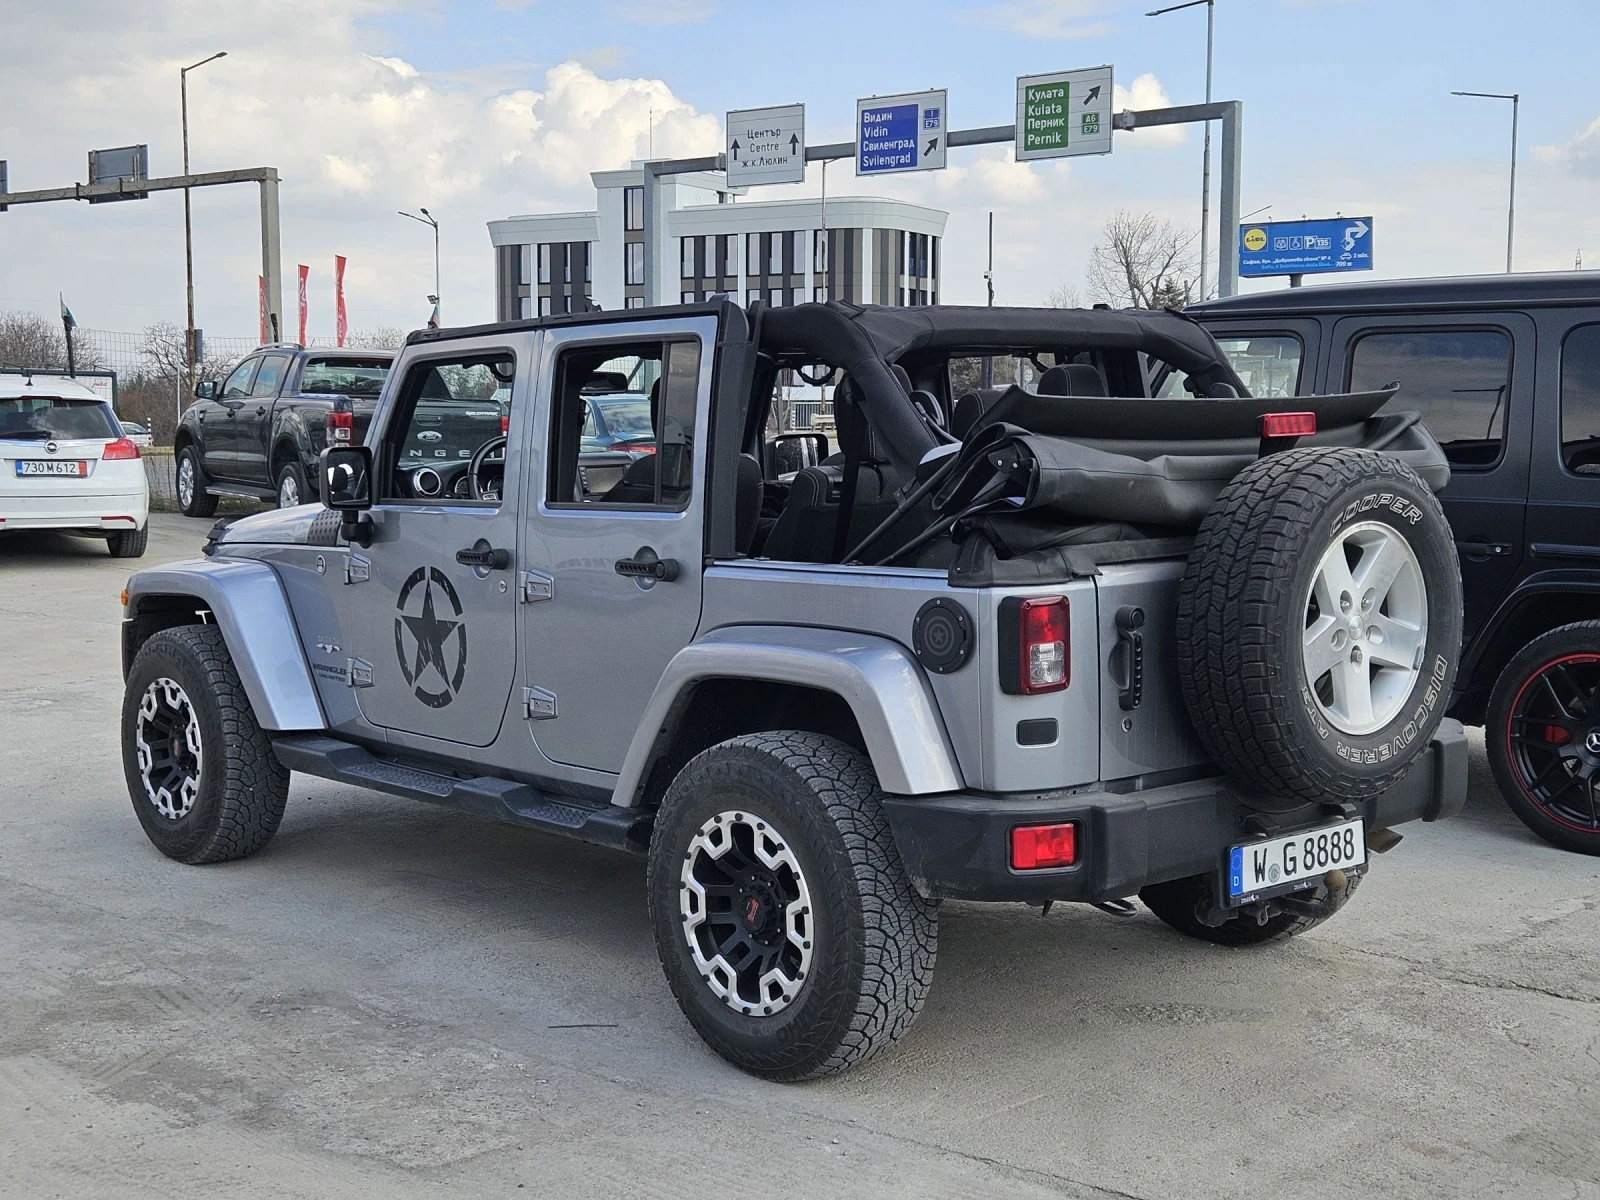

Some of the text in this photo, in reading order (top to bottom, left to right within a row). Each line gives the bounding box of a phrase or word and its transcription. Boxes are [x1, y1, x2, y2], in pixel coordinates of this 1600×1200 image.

[1028, 89, 1064, 102] Кулата
[1028, 103, 1062, 116] Kulata
[863, 112, 893, 123] Видин
[1027, 117, 1065, 130] Перник
[1085, 115, 1096, 123] A6
[925, 120, 938, 128] E79
[1083, 124, 1098, 133] E79
[747, 128, 781, 140] Център
[863, 127, 888, 138] Vidin
[1027, 131, 1062, 146] Pernik
[749, 142, 779, 153] Centre
[863, 139, 915, 152] Свиленград
[863, 152, 911, 167] Svilengrad
[1317, 239, 1329, 247] 135
[1328, 493, 1424, 538] COOPER
[1335, 654, 1448, 764] DISCOVERER
[1253, 848, 1268, 883] W
[1233, 876, 1240, 887] D
